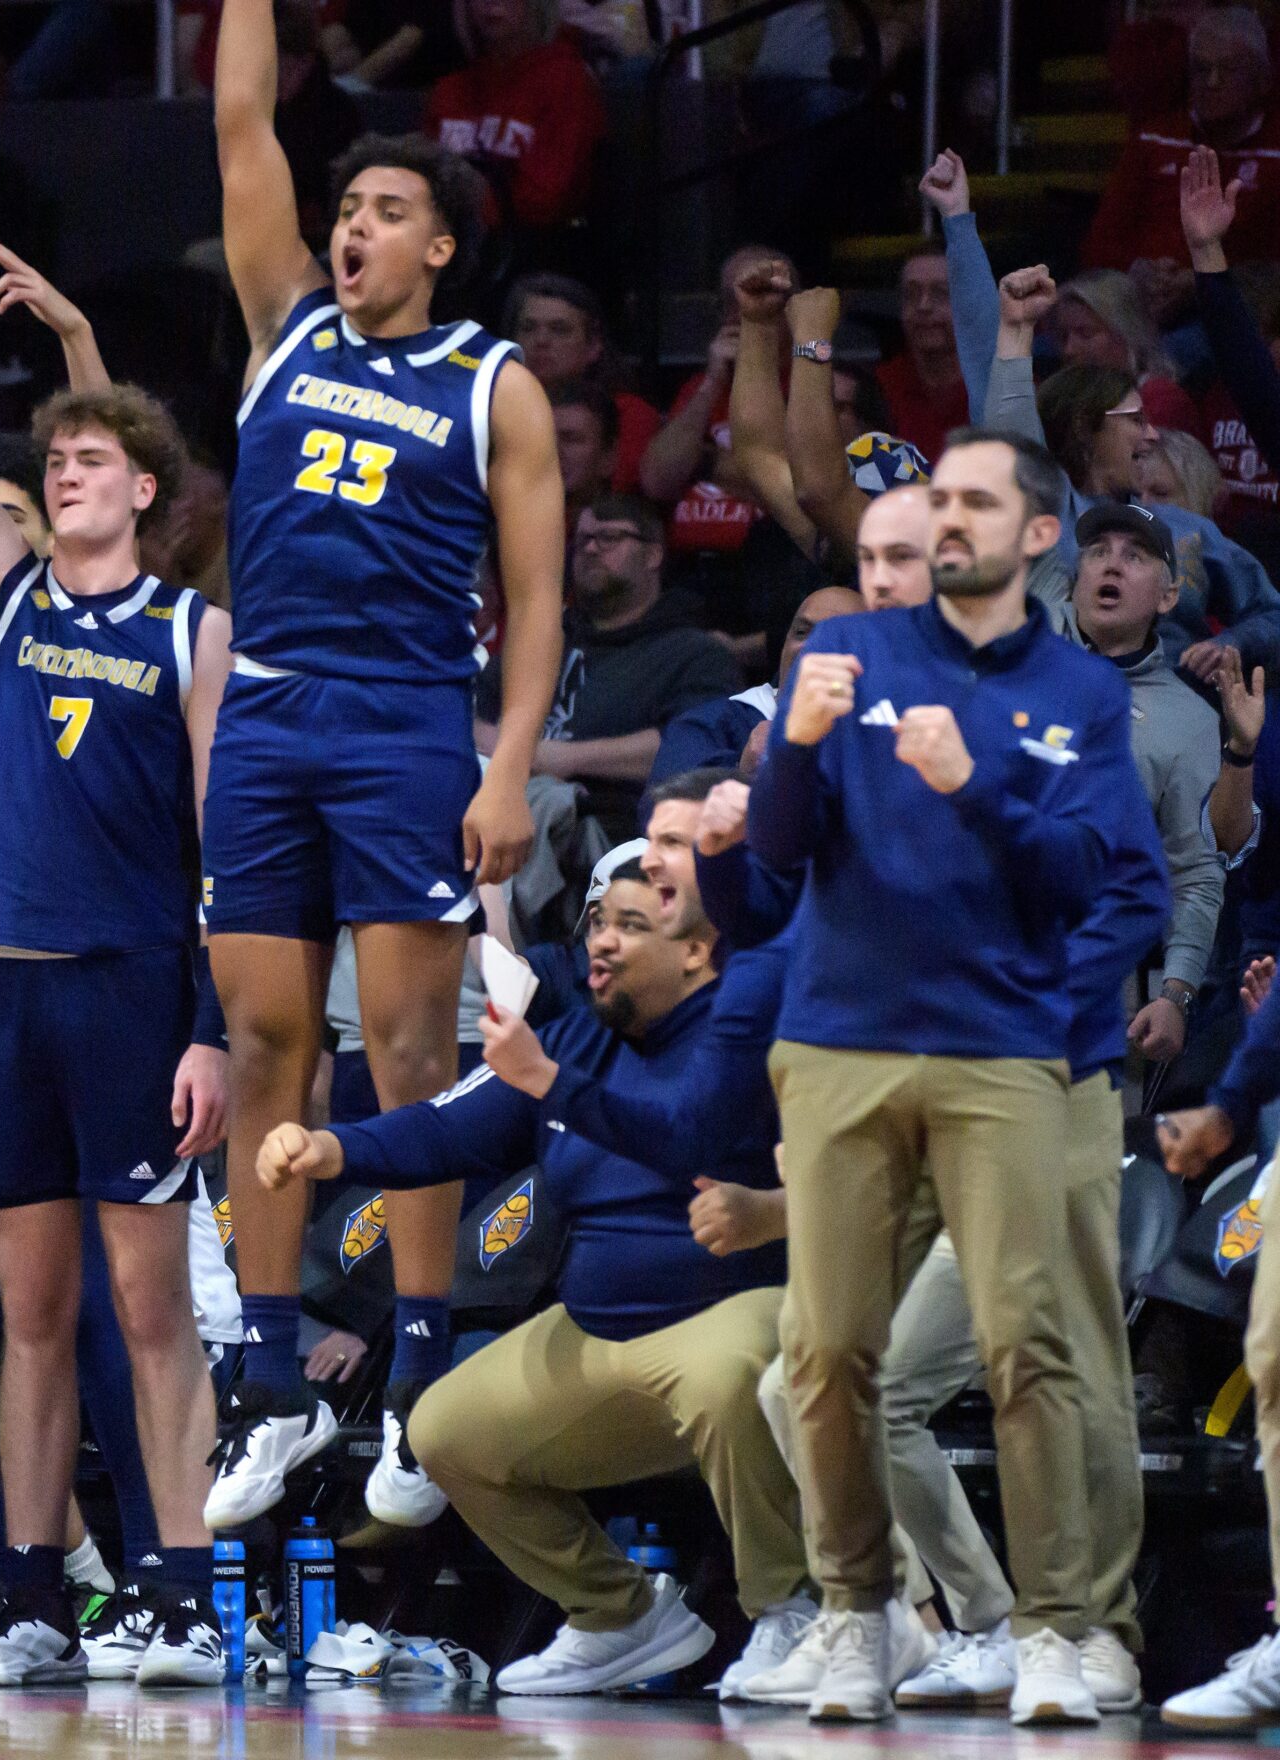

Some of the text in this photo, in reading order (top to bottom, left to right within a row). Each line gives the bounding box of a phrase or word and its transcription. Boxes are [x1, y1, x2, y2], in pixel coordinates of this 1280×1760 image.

[286, 372, 454, 449] CHATTANOOGA
[293, 428, 398, 507] 23
[48, 694, 95, 761] 7
[352, 1216, 382, 1242] NIT
[489, 1217, 525, 1234] NIT
[286, 1561, 302, 1657] POWERADE
